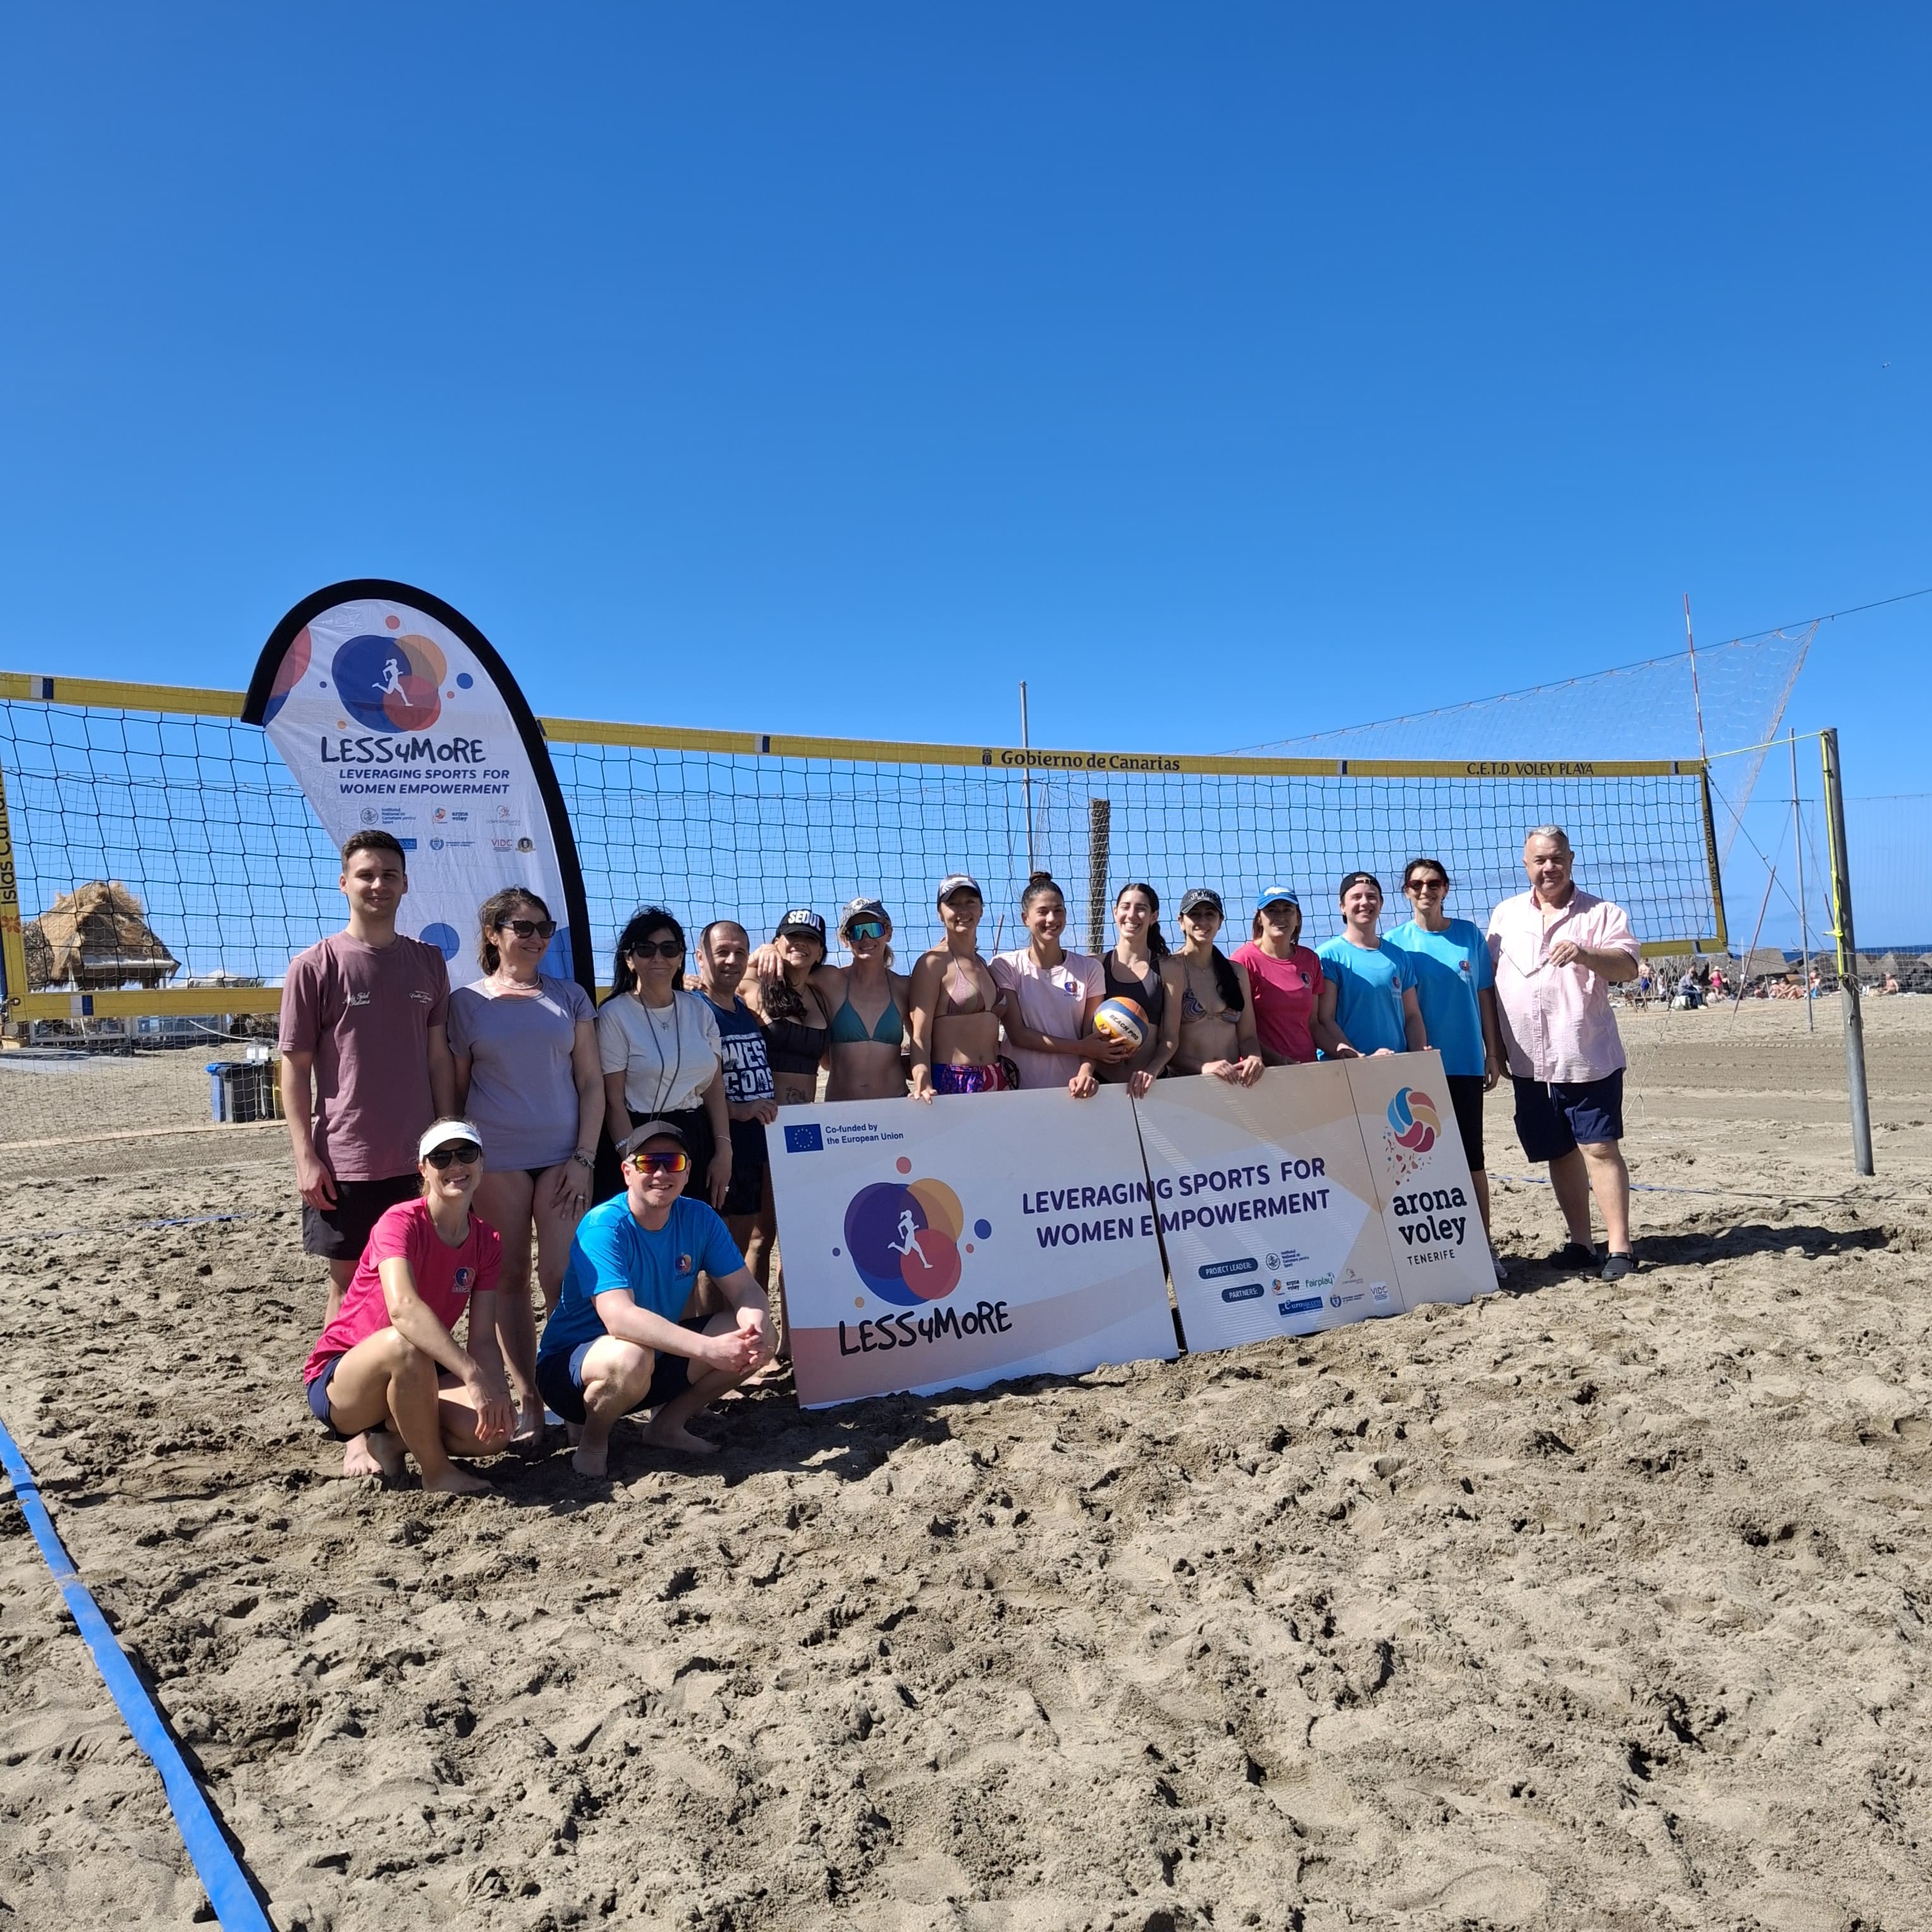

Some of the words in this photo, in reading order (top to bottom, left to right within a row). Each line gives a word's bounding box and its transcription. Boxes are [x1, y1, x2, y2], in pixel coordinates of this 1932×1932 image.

[1001, 750, 1083, 767] Gobierno
[1086, 754, 1106, 769] de
[1109, 755, 1180, 771] Canarias
[1467, 762, 1510, 775] C.E.T.D
[1515, 763, 1554, 775] VOLEY
[1560, 763, 1594, 775] PLAYA
[339, 769, 422, 780] LEVERAGING
[425, 769, 477, 780] SPORTS
[483, 769, 510, 780] FOR
[339, 784, 396, 795] WOMEN
[399, 783, 510, 795] EMPOWERMENT
[1704, 809, 1715, 864] Canarias
[0, 860, 17, 905] Islas
[788, 910, 821, 931] SEOUL
[1110, 1014, 1129, 1032] BEACH
[1128, 1029, 1139, 1041] PRO
[723, 1067, 774, 1094] COAS
[825, 1123, 867, 1134] Co-funded
[867, 1123, 877, 1132] by
[827, 1137, 840, 1145] the
[841, 1135, 879, 1144] European
[881, 1132, 904, 1140] Union
[1022, 1178, 1173, 1214] LEVERAGING
[1179, 1165, 1270, 1197] SPORTS
[1280, 1158, 1325, 1182] FOR
[1393, 1187, 1467, 1216] arona
[1036, 1217, 1134, 1249] WOMEN
[1140, 1189, 1330, 1237] EMPOWERMENT
[1398, 1215, 1466, 1245] voley
[1407, 1249, 1455, 1266] TENERIFE
[1206, 1266, 1230, 1276] PROJECT
[1228, 1288, 1259, 1299] PARTNERS:
[1370, 1286, 1388, 1295] VIDC
